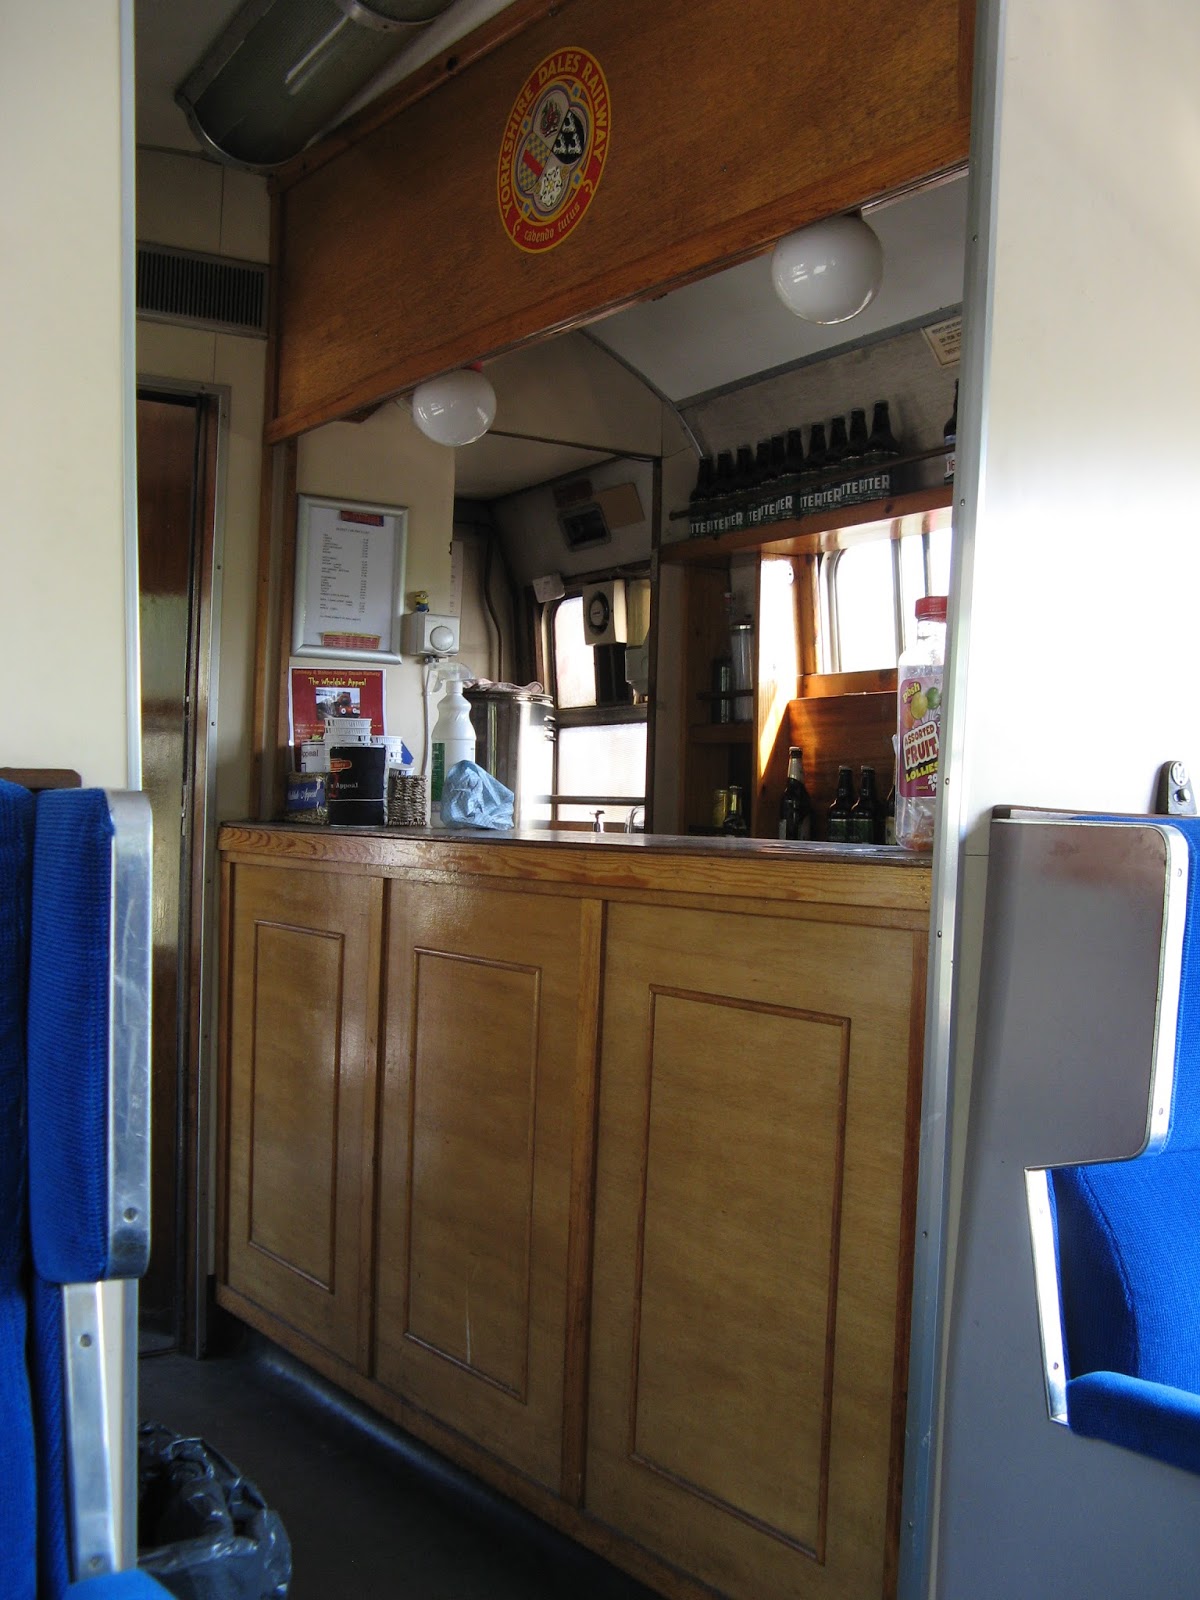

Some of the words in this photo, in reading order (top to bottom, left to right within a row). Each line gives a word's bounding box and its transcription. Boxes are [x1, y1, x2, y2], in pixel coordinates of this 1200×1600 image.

[500, 84, 534, 219] YORKSHIRE
[538, 54, 582, 86] DALES
[582, 61, 607, 163] RAILWAY
[308, 677, 320, 686] The
[348, 677, 367, 688] Appeal
[904, 724, 935, 747] ASSORTED
[905, 738, 937, 768] FRUIT
[905, 761, 939, 783] LOLLIES
